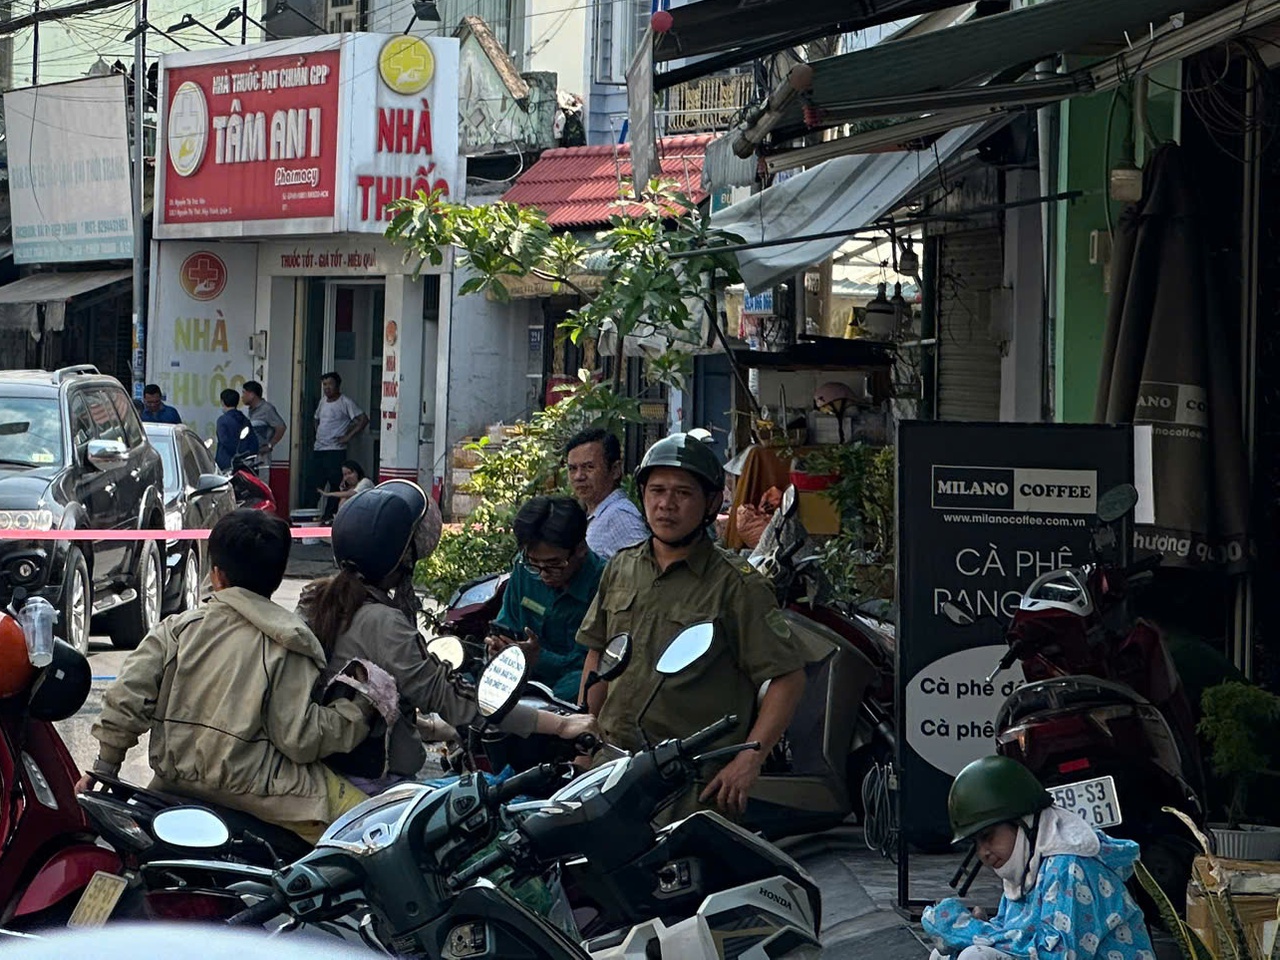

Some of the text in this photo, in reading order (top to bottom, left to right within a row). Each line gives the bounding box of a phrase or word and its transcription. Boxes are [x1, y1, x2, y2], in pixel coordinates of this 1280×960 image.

[212, 56, 331, 95] NHÀ THUỐC ĐẠT CHUẨN GPP
[213, 98, 321, 164] TÂM AN 1
[376, 98, 433, 155] NHÀ
[275, 167, 320, 187] Pharmacy
[281, 247, 300, 268] THUỐC
[302, 247, 314, 268] TỐT
[330, 247, 343, 268] TỐT
[174, 309, 229, 353] NHÀ
[1137, 396, 1171, 409] ANO
[937, 479, 1091, 499] MILANO COFFEE
[943, 513, 1086, 527] www.milanocoffee.com.vn
[956, 543, 1006, 576] CÀ
[920, 677, 949, 695] Cà
[957, 679, 995, 699] phê
[920, 719, 995, 741] Cà phê
[1054, 782, 1106, 809] 59-S3
[759, 887, 793, 912] HONDA
